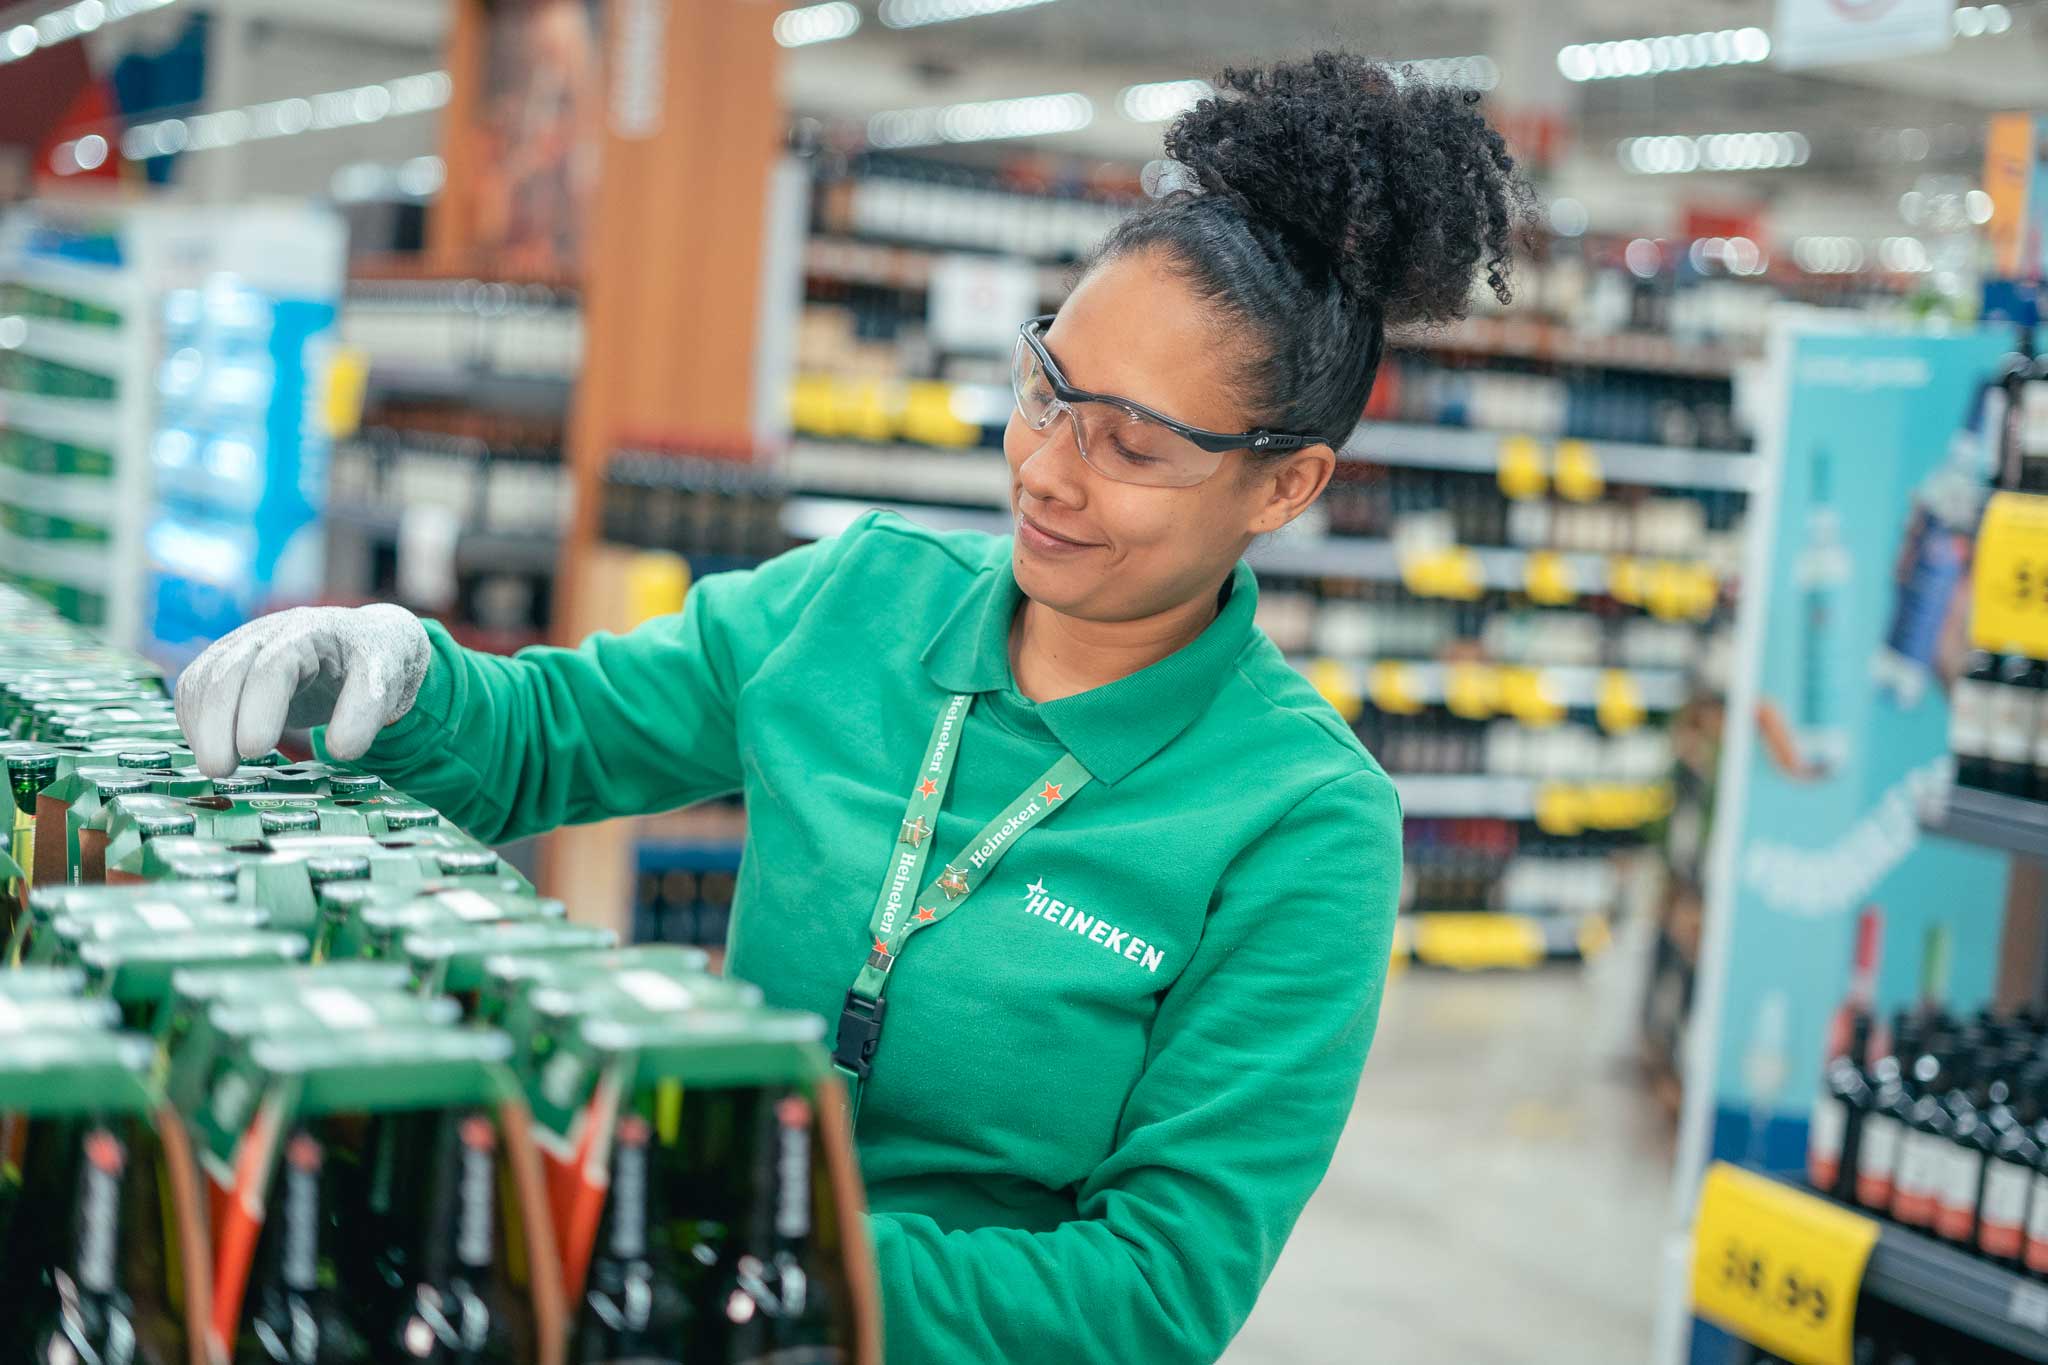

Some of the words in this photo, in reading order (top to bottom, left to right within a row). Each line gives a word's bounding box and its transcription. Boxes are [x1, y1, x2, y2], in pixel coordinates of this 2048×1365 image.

[929, 694, 966, 773] Heineken
[969, 801, 1042, 869] Heineken
[880, 853, 917, 934] Heineken
[1024, 892, 1166, 973] HEINEKEN
